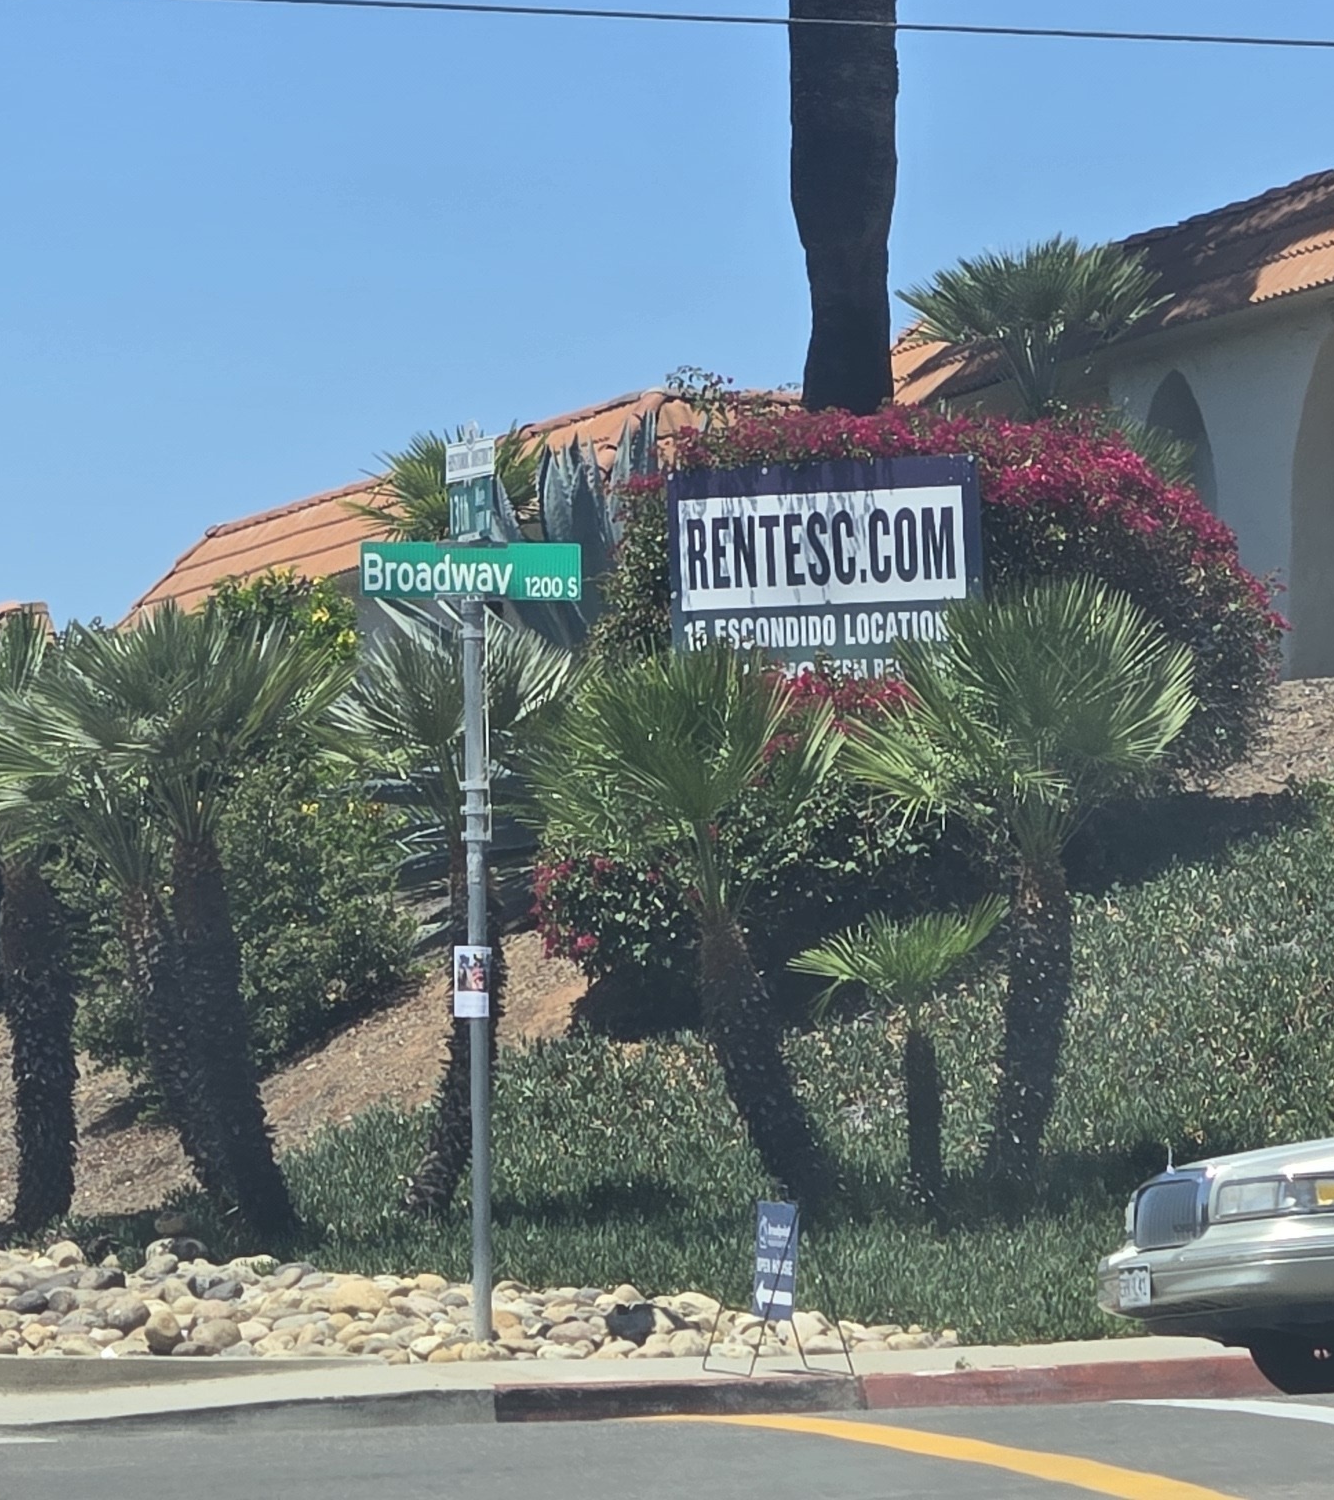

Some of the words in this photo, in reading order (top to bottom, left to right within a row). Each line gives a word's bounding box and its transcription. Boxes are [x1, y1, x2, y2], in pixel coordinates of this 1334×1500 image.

[687, 506, 956, 590] RENTESC.COM
[363, 552, 514, 595] Broadway
[525, 576, 563, 598] 1200
[567, 577, 579, 598] S
[714, 614, 836, 650] ESCONDIDO
